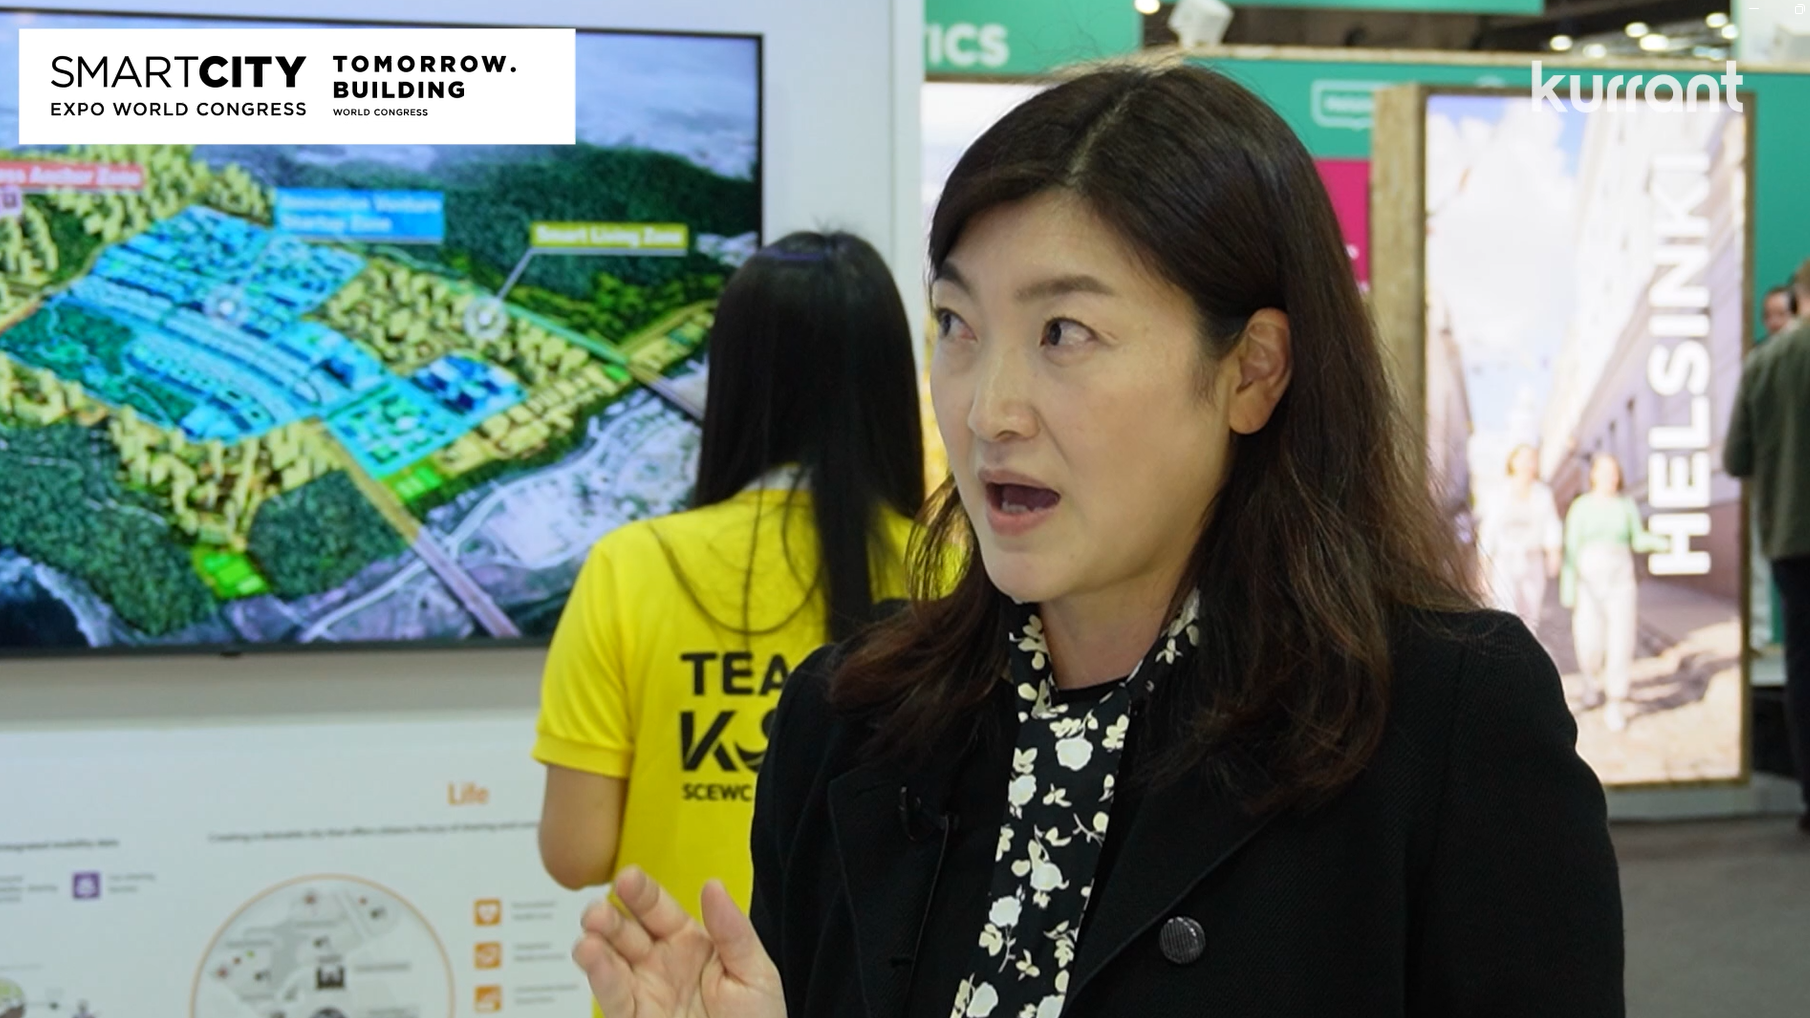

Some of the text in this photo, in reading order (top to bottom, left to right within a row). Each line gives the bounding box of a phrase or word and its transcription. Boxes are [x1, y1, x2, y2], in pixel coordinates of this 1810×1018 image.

[928, 22, 1010, 67] ICS
[1648, 153, 1711, 575] HELSINKI
[680, 651, 789, 696] TEA
